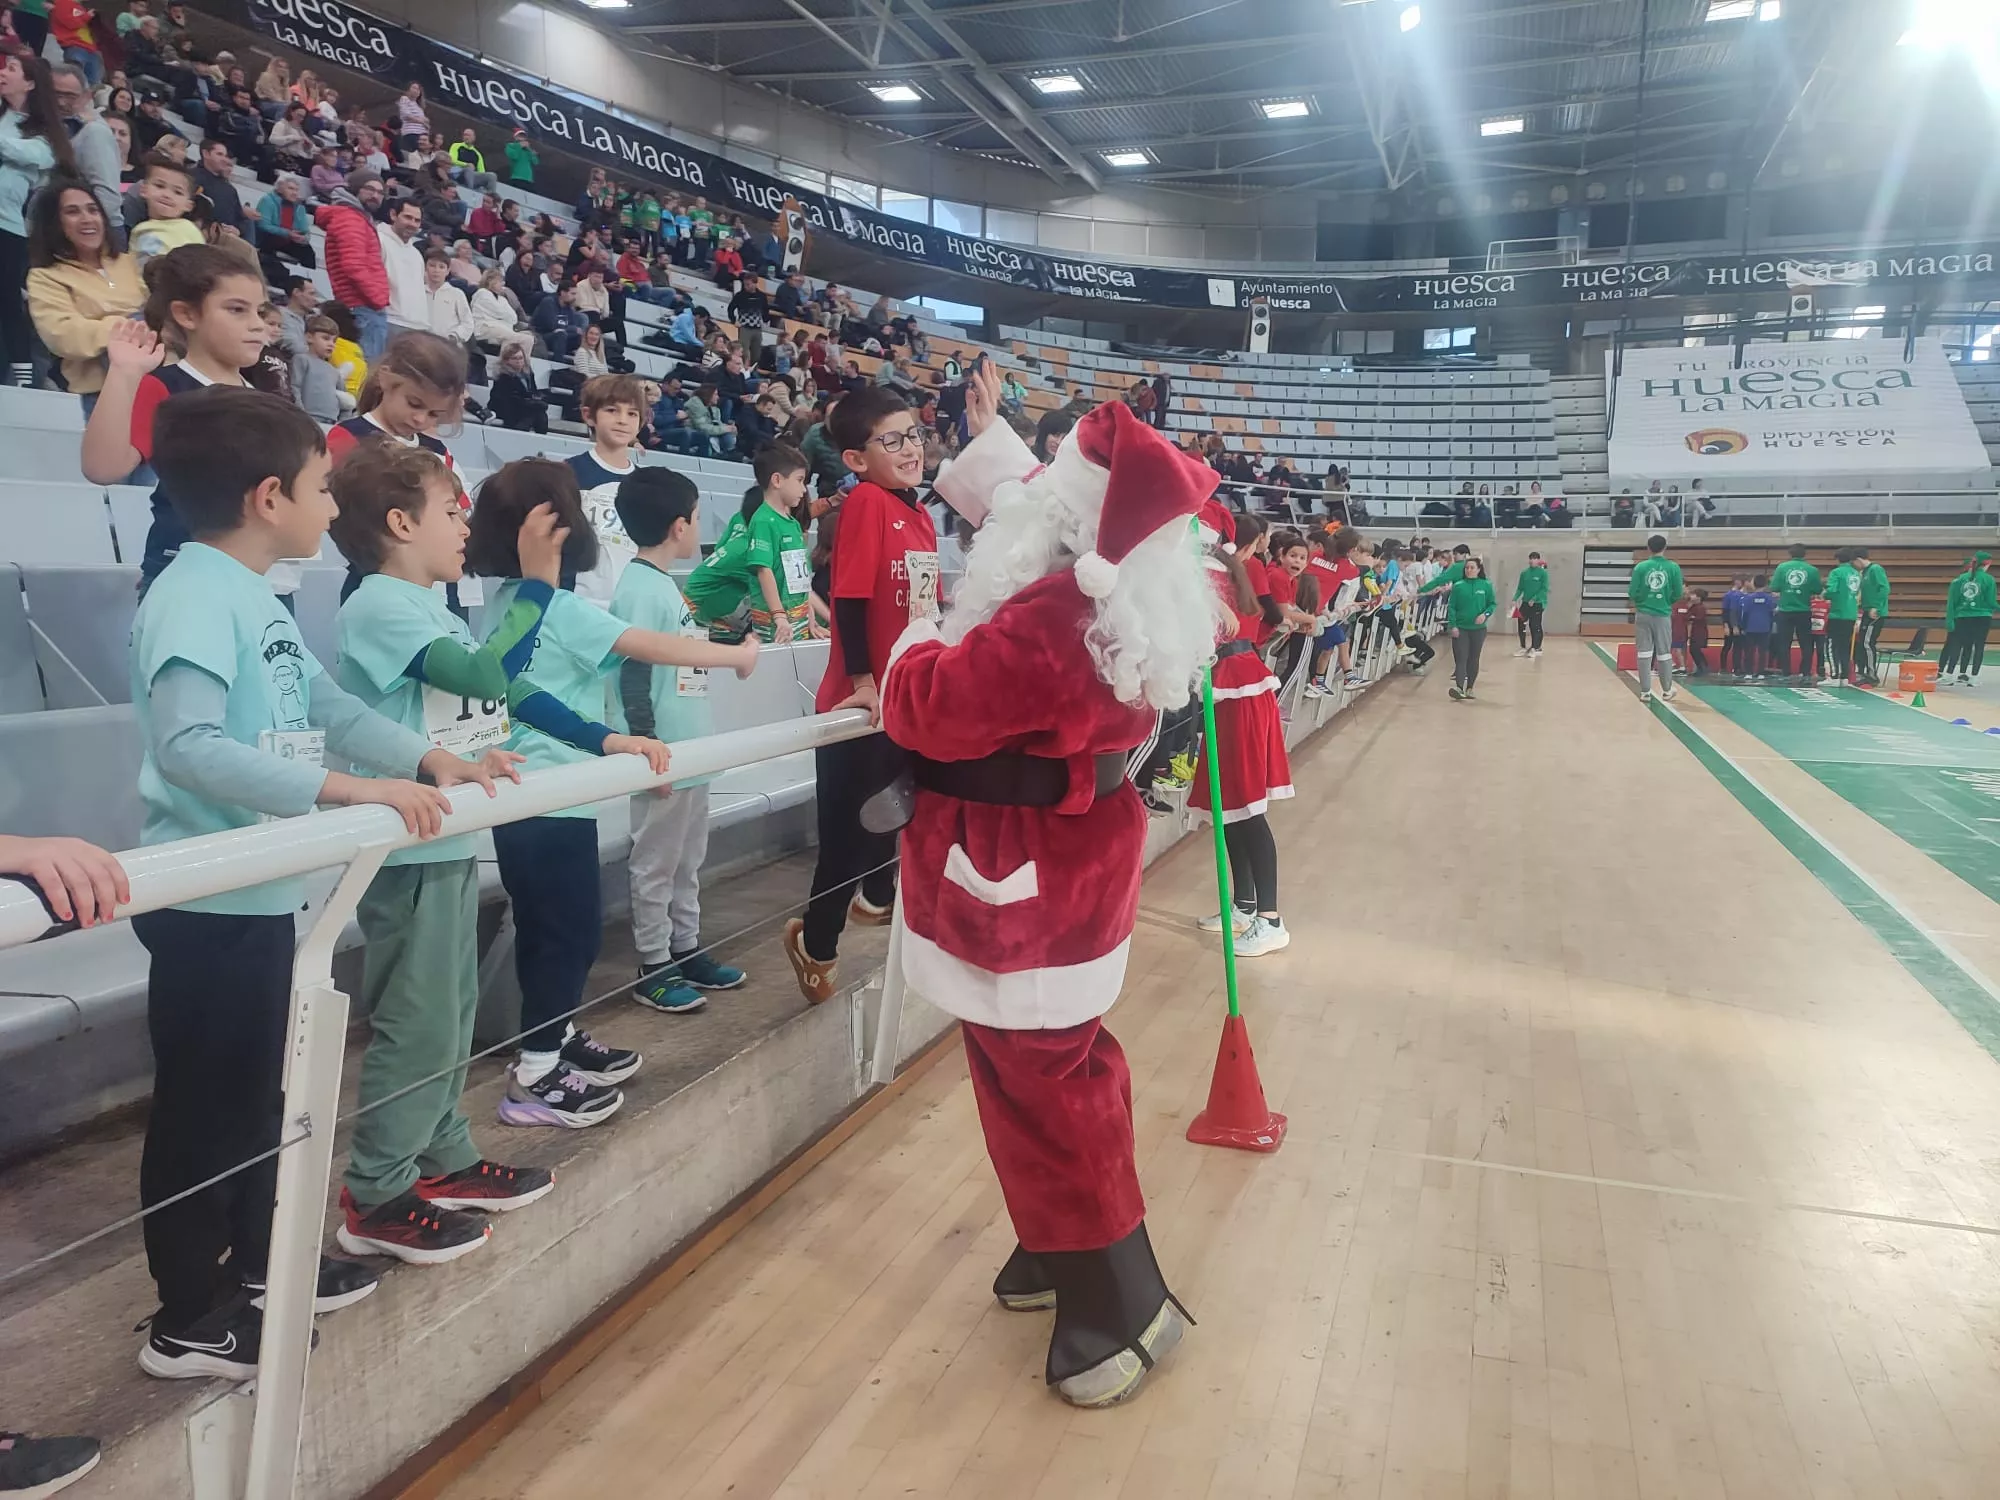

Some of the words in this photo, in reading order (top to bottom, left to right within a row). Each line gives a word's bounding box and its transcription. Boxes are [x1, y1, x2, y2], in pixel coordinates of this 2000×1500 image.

[257, 0, 395, 58] uesca
[272, 22, 300, 47] La
[433, 61, 572, 139] Huesca
[576, 118, 615, 154] La
[945, 235, 1022, 270] Huesca
[1053, 262, 1136, 287] Huesca
[1413, 275, 1516, 295] Huesca
[1561, 265, 1670, 287] Huesca
[1241, 280, 1333, 295] Ayuntamiento
[1640, 368, 1918, 397] Huesca
[1764, 438, 1896, 448] HUESCA
